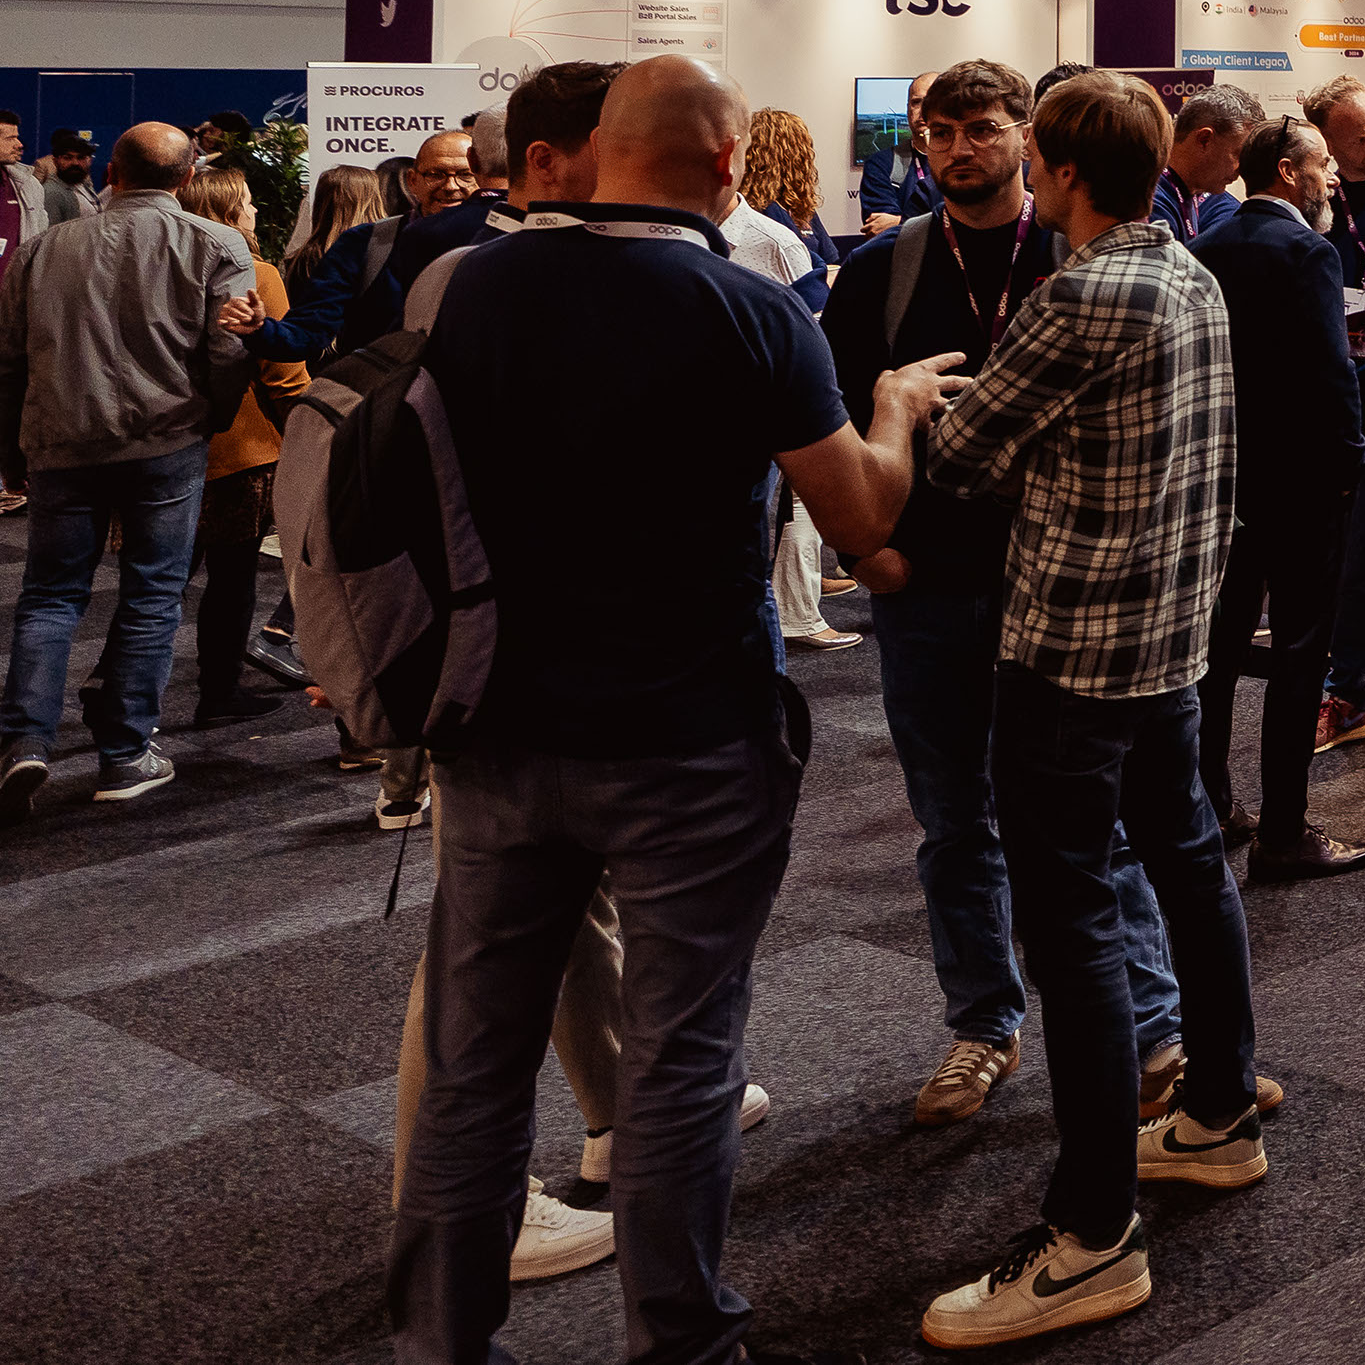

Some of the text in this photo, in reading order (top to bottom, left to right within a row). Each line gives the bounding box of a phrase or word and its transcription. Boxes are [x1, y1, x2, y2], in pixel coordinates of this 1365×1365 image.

[638, 4, 690, 13] Website Sales
[1226, 6, 1289, 16] India Malaysia
[654, 13, 677, 21] Portal
[678, 14, 697, 22] Sales
[1343, 16, 1365, 25] odoo
[637, 37, 685, 46] Sales Agents
[1189, 54, 1222, 66] Global
[1224, 55, 1252, 66] Client
[1254, 56, 1288, 70] Legacy
[340, 86, 425, 97] PROCUROS
[1162, 81, 1206, 96] odoo
[325, 116, 445, 132] INTEGRATE
[325, 137, 396, 153] ONCE.
[1020, 199, 1032, 221] odoo
[648, 224, 682, 237] odoo
[998, 291, 1008, 317] odoo
